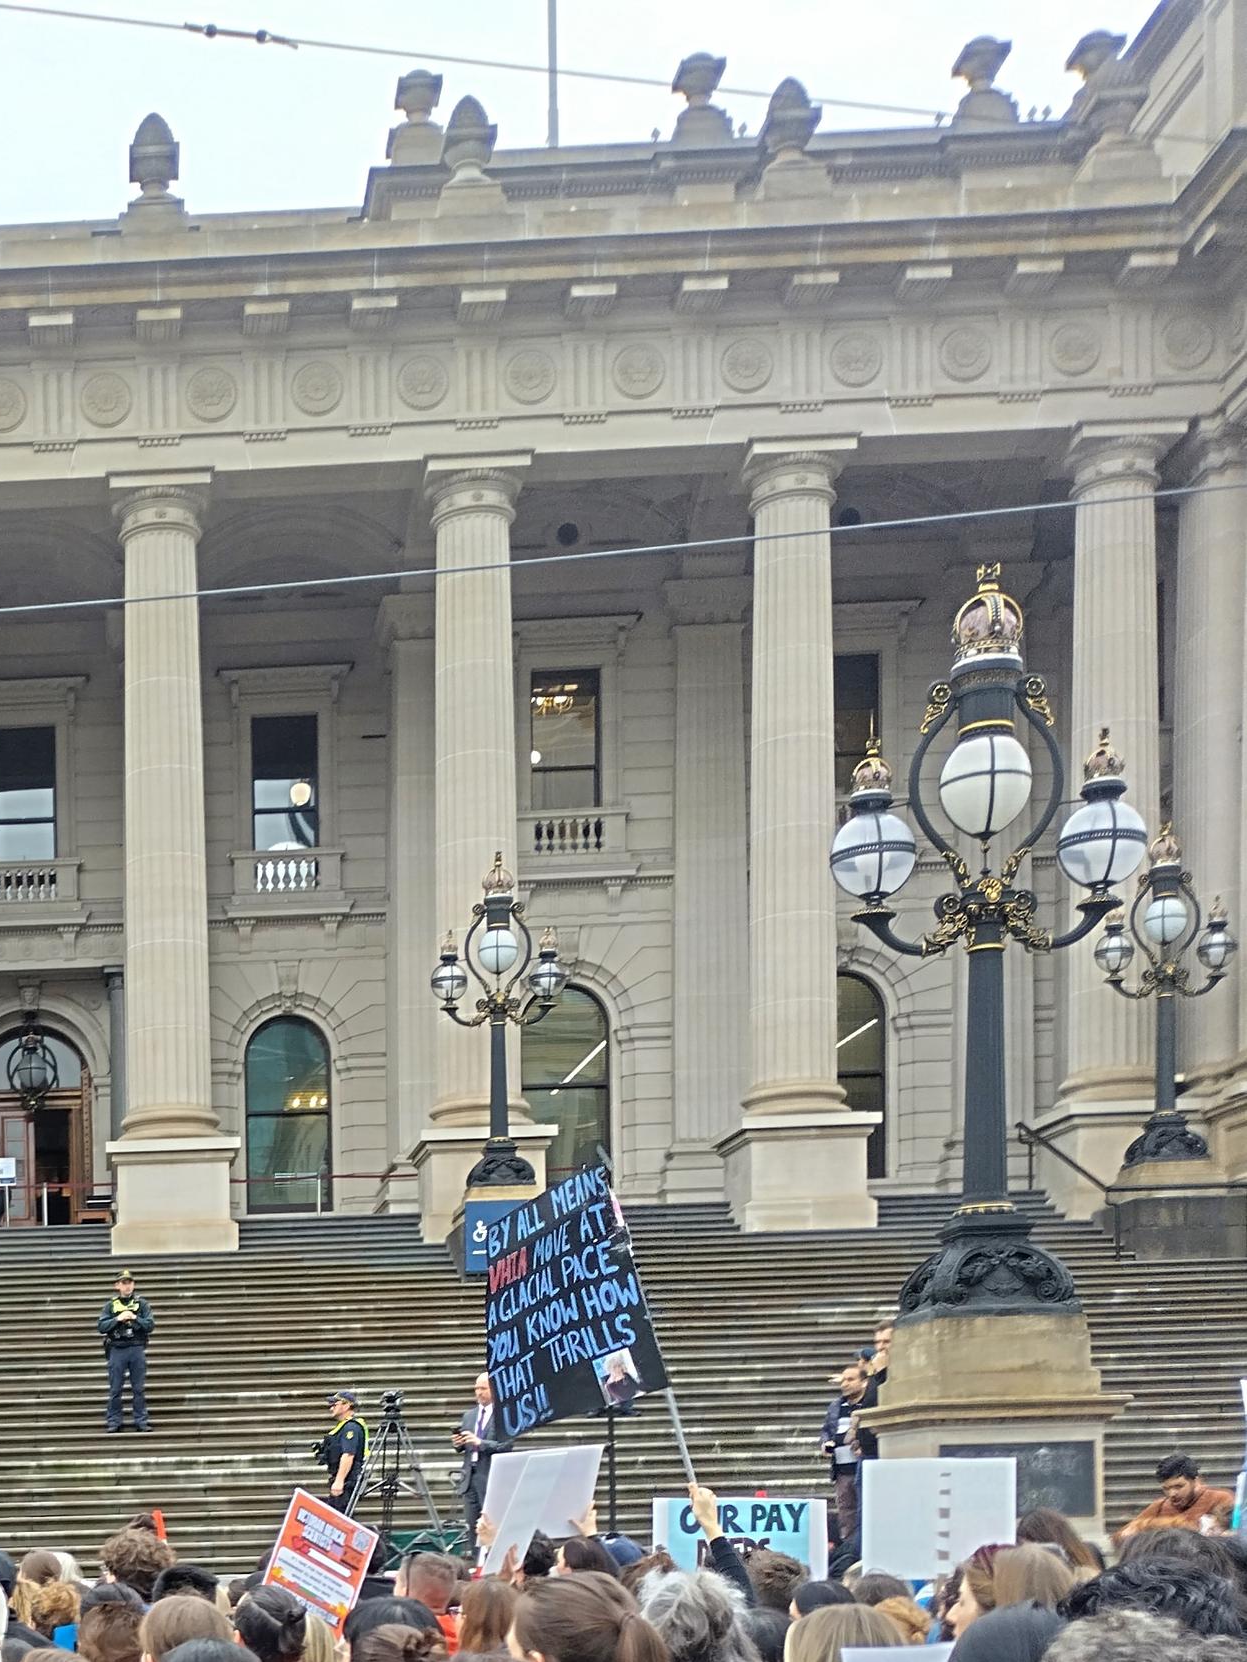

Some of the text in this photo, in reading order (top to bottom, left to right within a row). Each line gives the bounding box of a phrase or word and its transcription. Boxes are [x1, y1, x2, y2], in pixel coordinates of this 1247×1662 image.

[487, 1166, 610, 1258] BY ALL MEANS
[533, 1220, 571, 1270] MOVE
[579, 1202, 607, 1240] AT
[487, 1241, 620, 1331] A GLACIAL PACE
[487, 1271, 641, 1369] YOU KNOW HOW
[488, 1312, 637, 1403] THAT THRILLS
[502, 1383, 554, 1437] US!!
[750, 1501, 810, 1533] PAY
